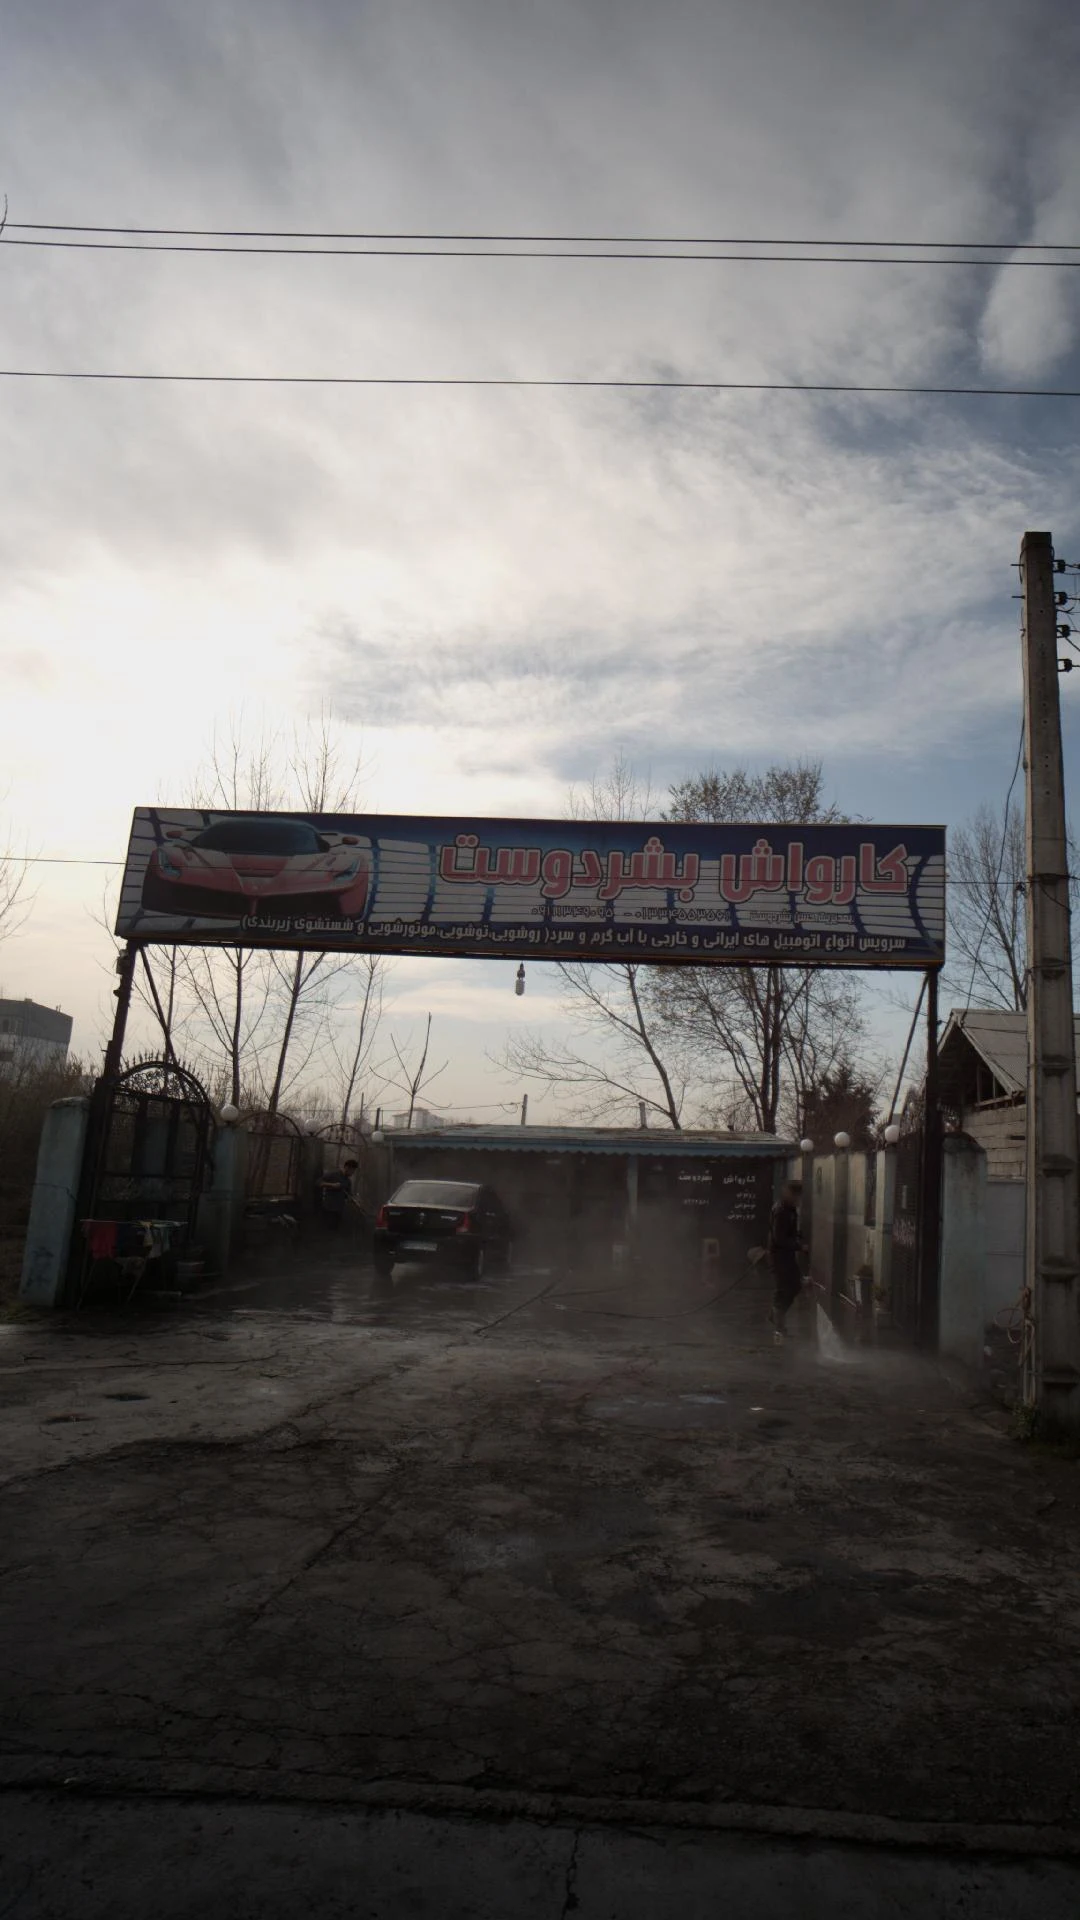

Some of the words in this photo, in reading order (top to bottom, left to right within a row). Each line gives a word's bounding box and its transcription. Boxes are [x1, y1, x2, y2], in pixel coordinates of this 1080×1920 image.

[438, 833, 699, 903] بشردوست
[720, 838, 908, 905] کارواش
[356, 922, 365, 935] و
[590, 928, 613, 945] گرم
[616, 926, 635, 946] آب
[578, 932, 587, 945] و
[637, 930, 647, 946] با
[651, 932, 688, 949] خارجی
[691, 936, 699, 948] و
[703, 931, 739, 949] ایرانی
[743, 934, 770, 947] های
[773, 934, 821, 951] اتومبیل
[825, 937, 855, 952] انواع
[858, 937, 906, 954] سرویس
